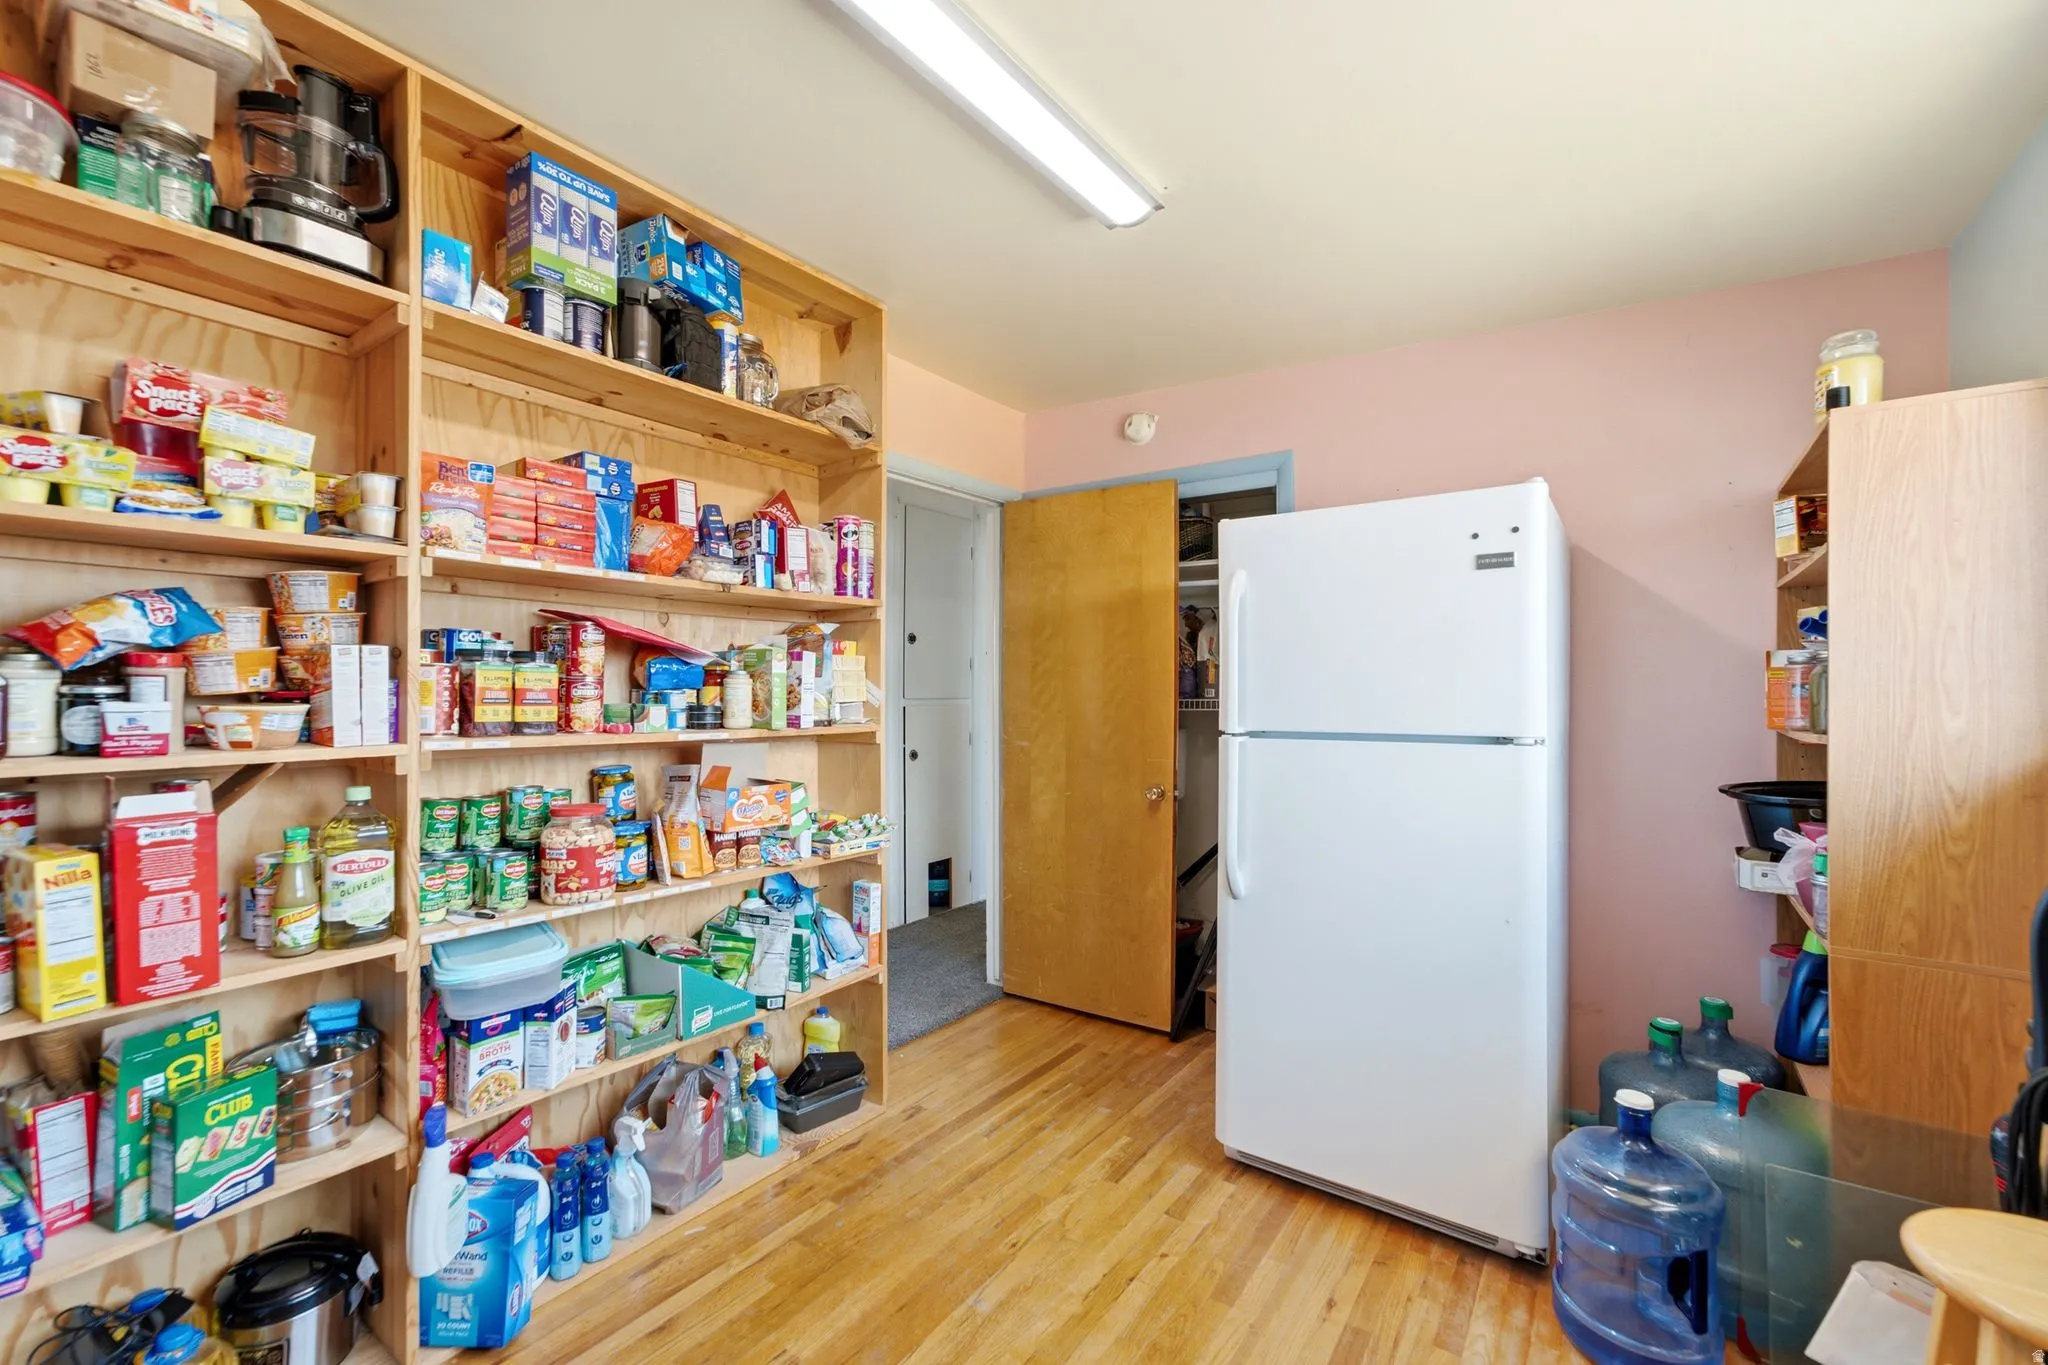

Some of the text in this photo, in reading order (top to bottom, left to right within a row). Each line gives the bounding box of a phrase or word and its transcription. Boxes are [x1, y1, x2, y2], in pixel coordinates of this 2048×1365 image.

[559, 172, 572, 185] TO
[573, 180, 587, 191] UP
[587, 185, 610, 203] SAVE
[134, 379, 205, 402] Snack
[149, 399, 202, 416] pack
[0, 438, 67, 456] Snack
[12, 453, 64, 468] pack
[210, 463, 260, 477] Snack
[222, 474, 260, 488] pack
[460, 632, 482, 642] GOY
[336, 859, 387, 872] BERTOLLI
[44, 869, 92, 890] Nilla
[340, 881, 368, 898] OLIVE
[372, 874, 385, 886] OIL
[480, 1044, 512, 1061] BROTH
[204, 1093, 254, 1126] CLUB
